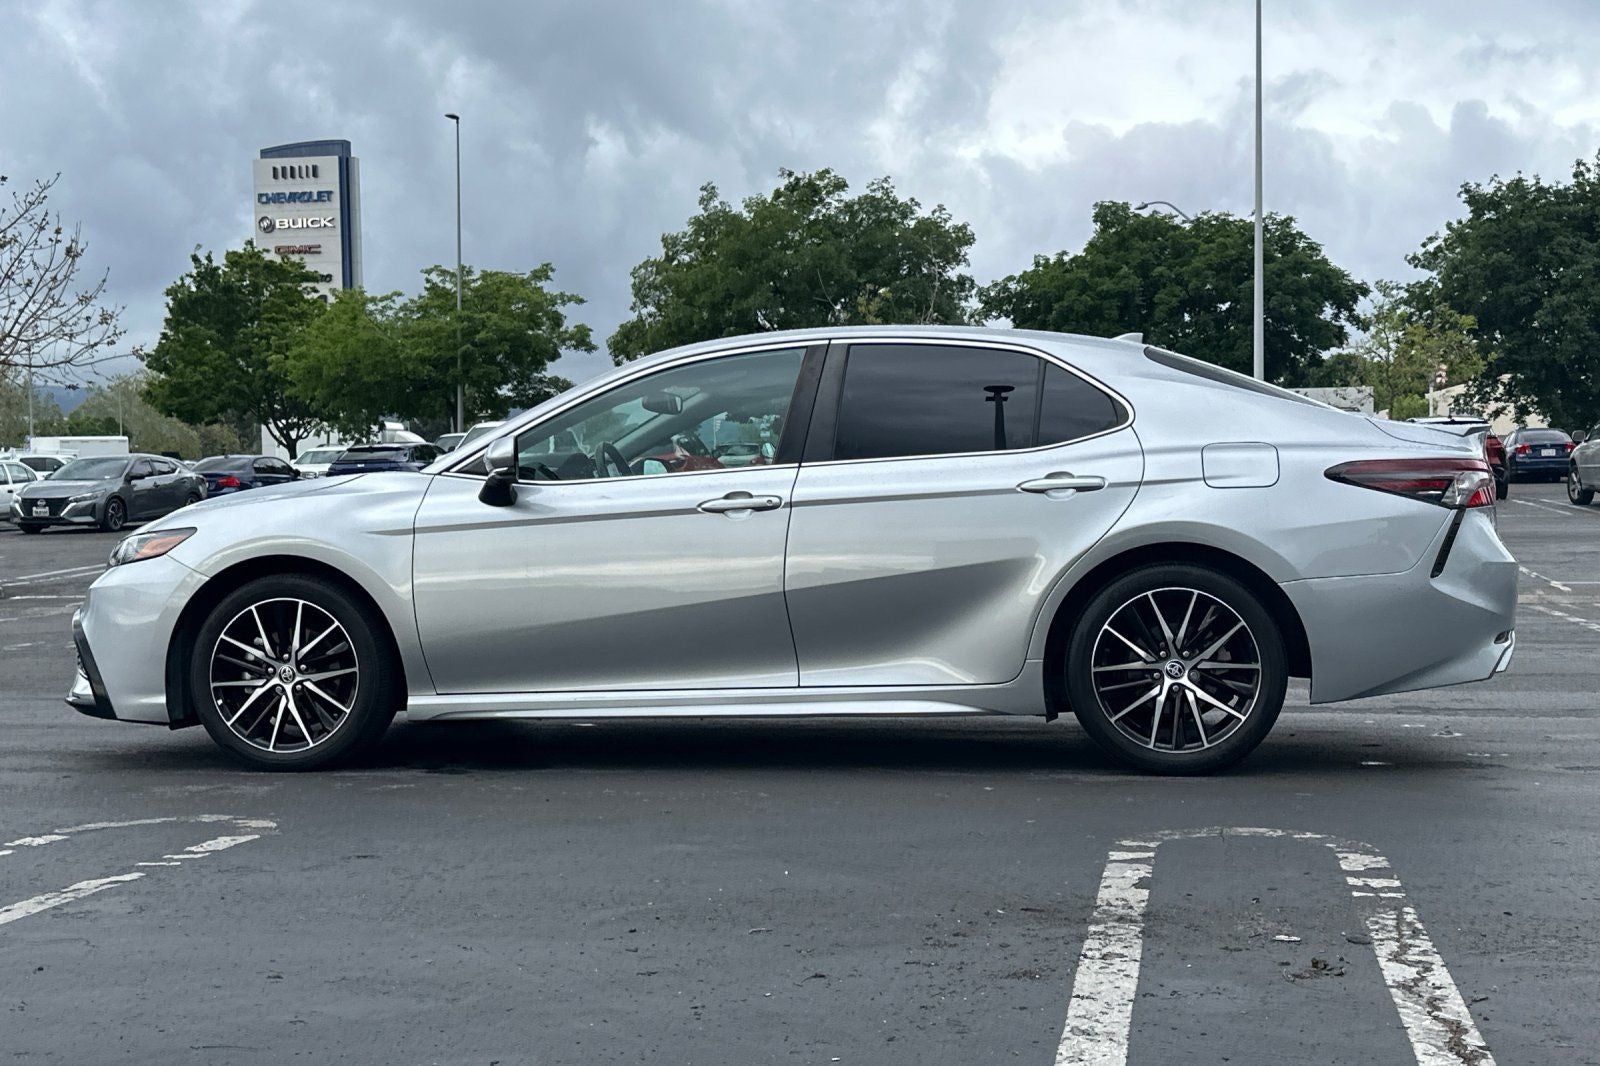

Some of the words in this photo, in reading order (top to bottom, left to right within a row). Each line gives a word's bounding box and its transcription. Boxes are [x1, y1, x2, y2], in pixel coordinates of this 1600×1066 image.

[258, 190, 334, 204] CHEVROLET
[275, 217, 335, 229] BUICK
[274, 244, 322, 255] GMC
